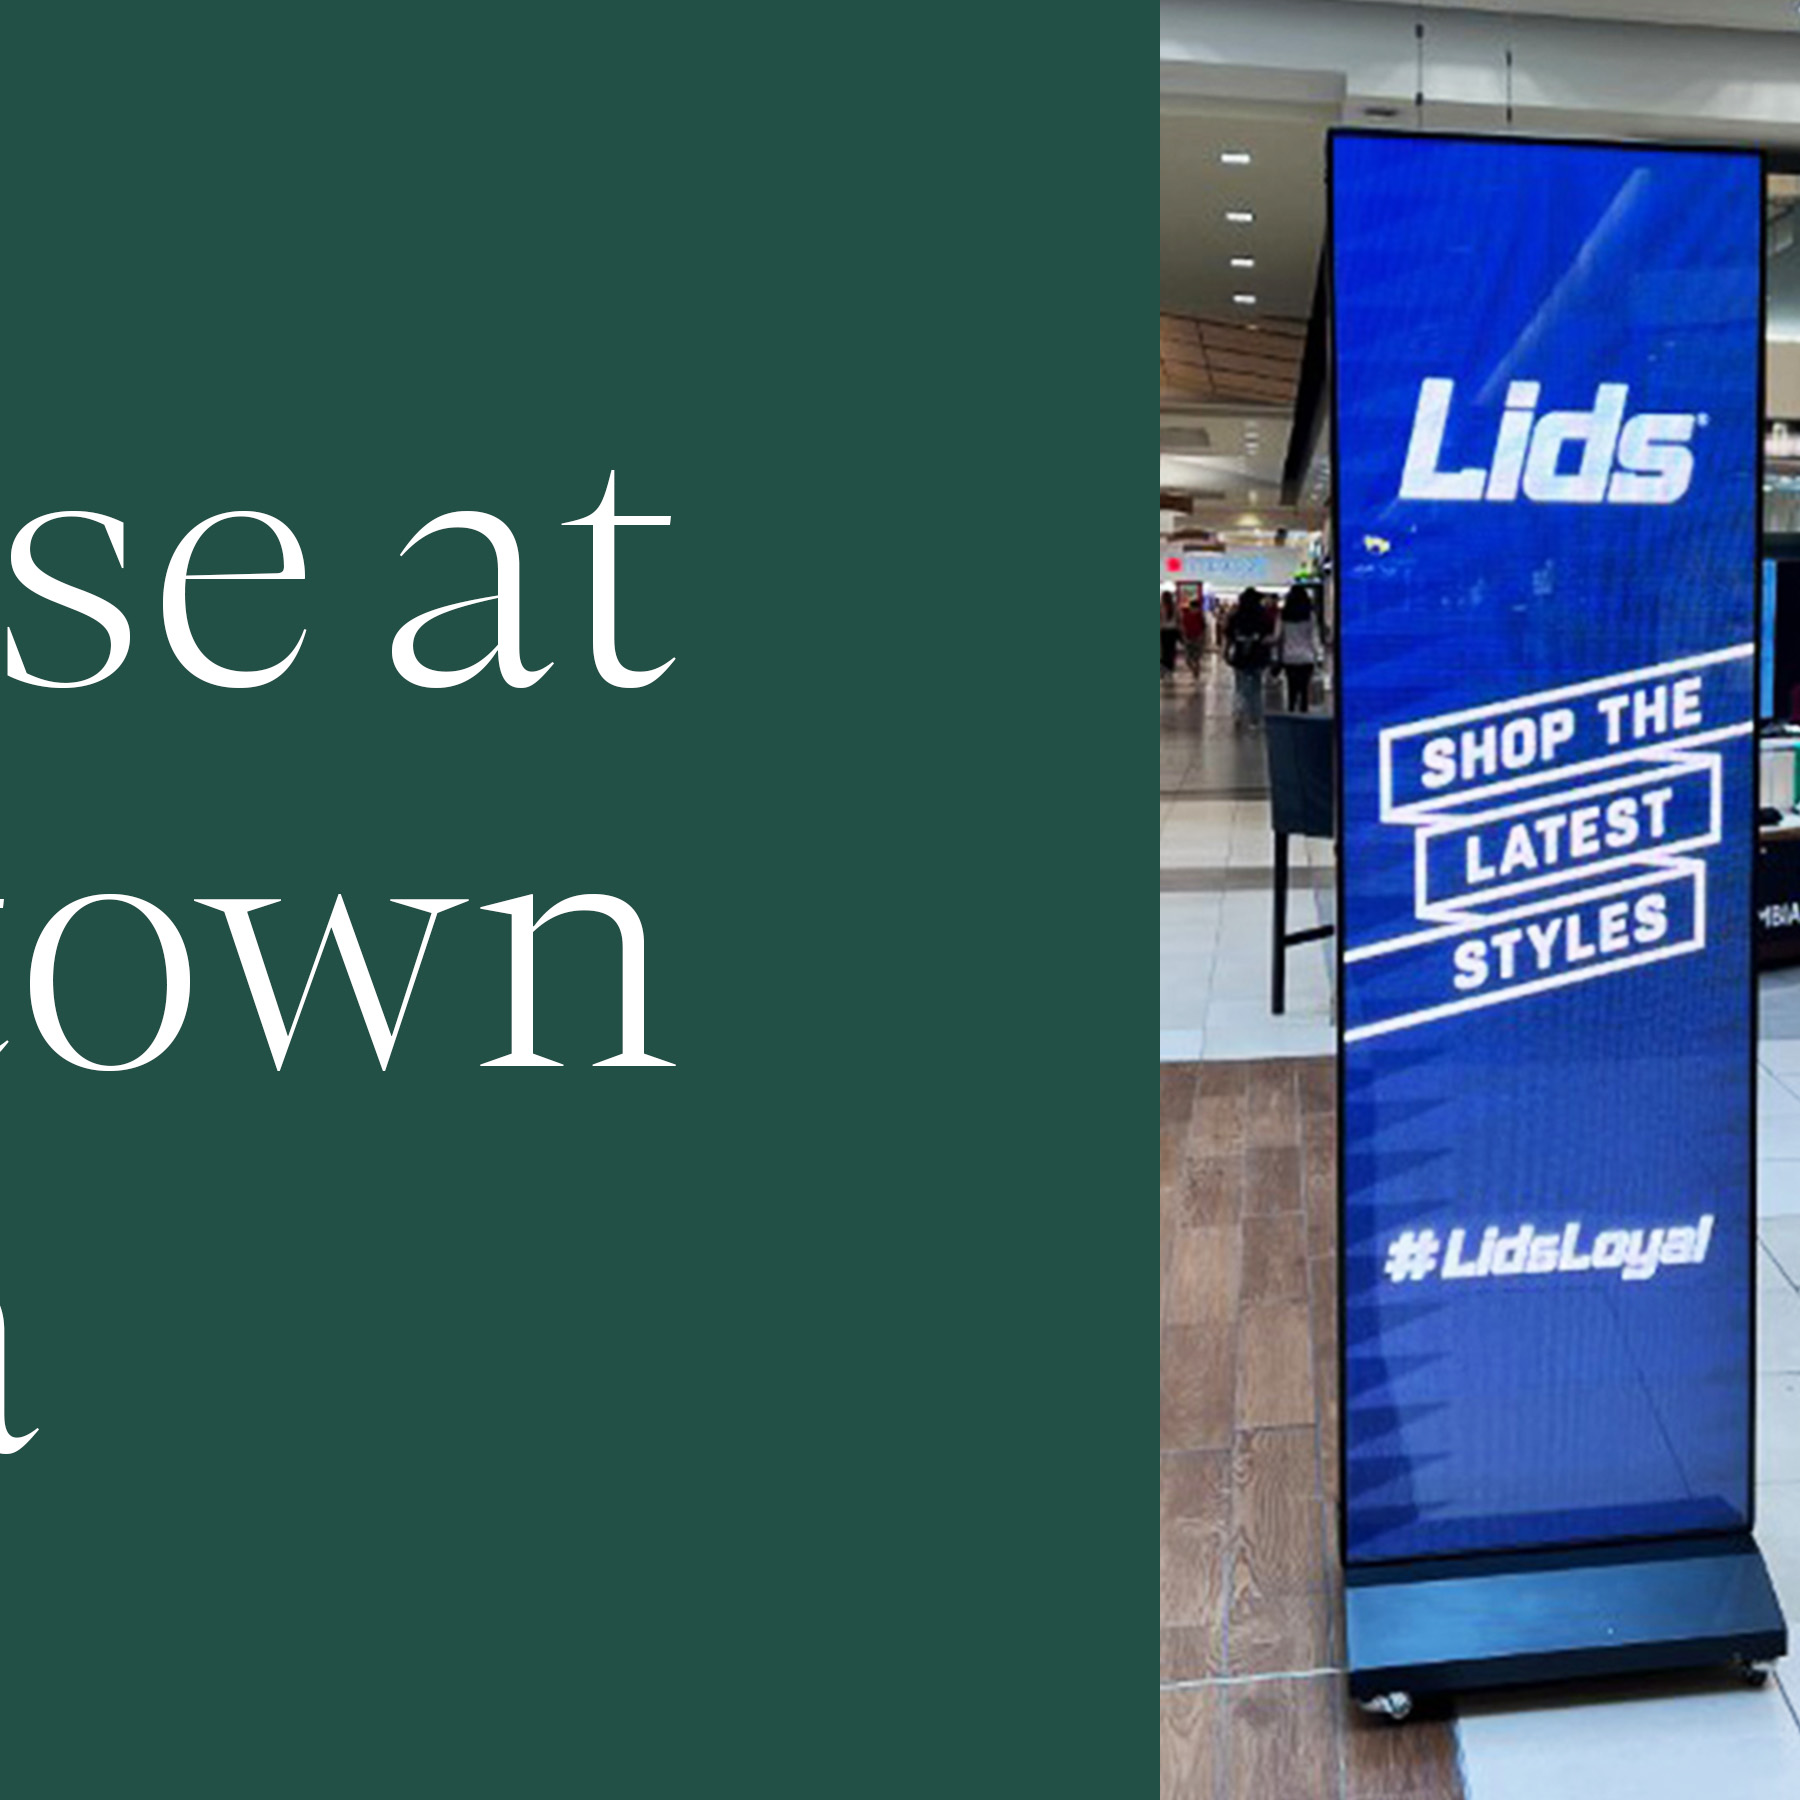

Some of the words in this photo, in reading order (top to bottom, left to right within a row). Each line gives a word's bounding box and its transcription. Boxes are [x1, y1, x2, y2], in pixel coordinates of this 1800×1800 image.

[1399, 377, 1696, 503] Lids
[1421, 708, 1575, 789] SHOP
[1597, 676, 1701, 745] THE
[1466, 787, 1673, 884] LATEST
[1453, 893, 1666, 990] STYLES
[1384, 1213, 1715, 1283] #LidsLoyal
